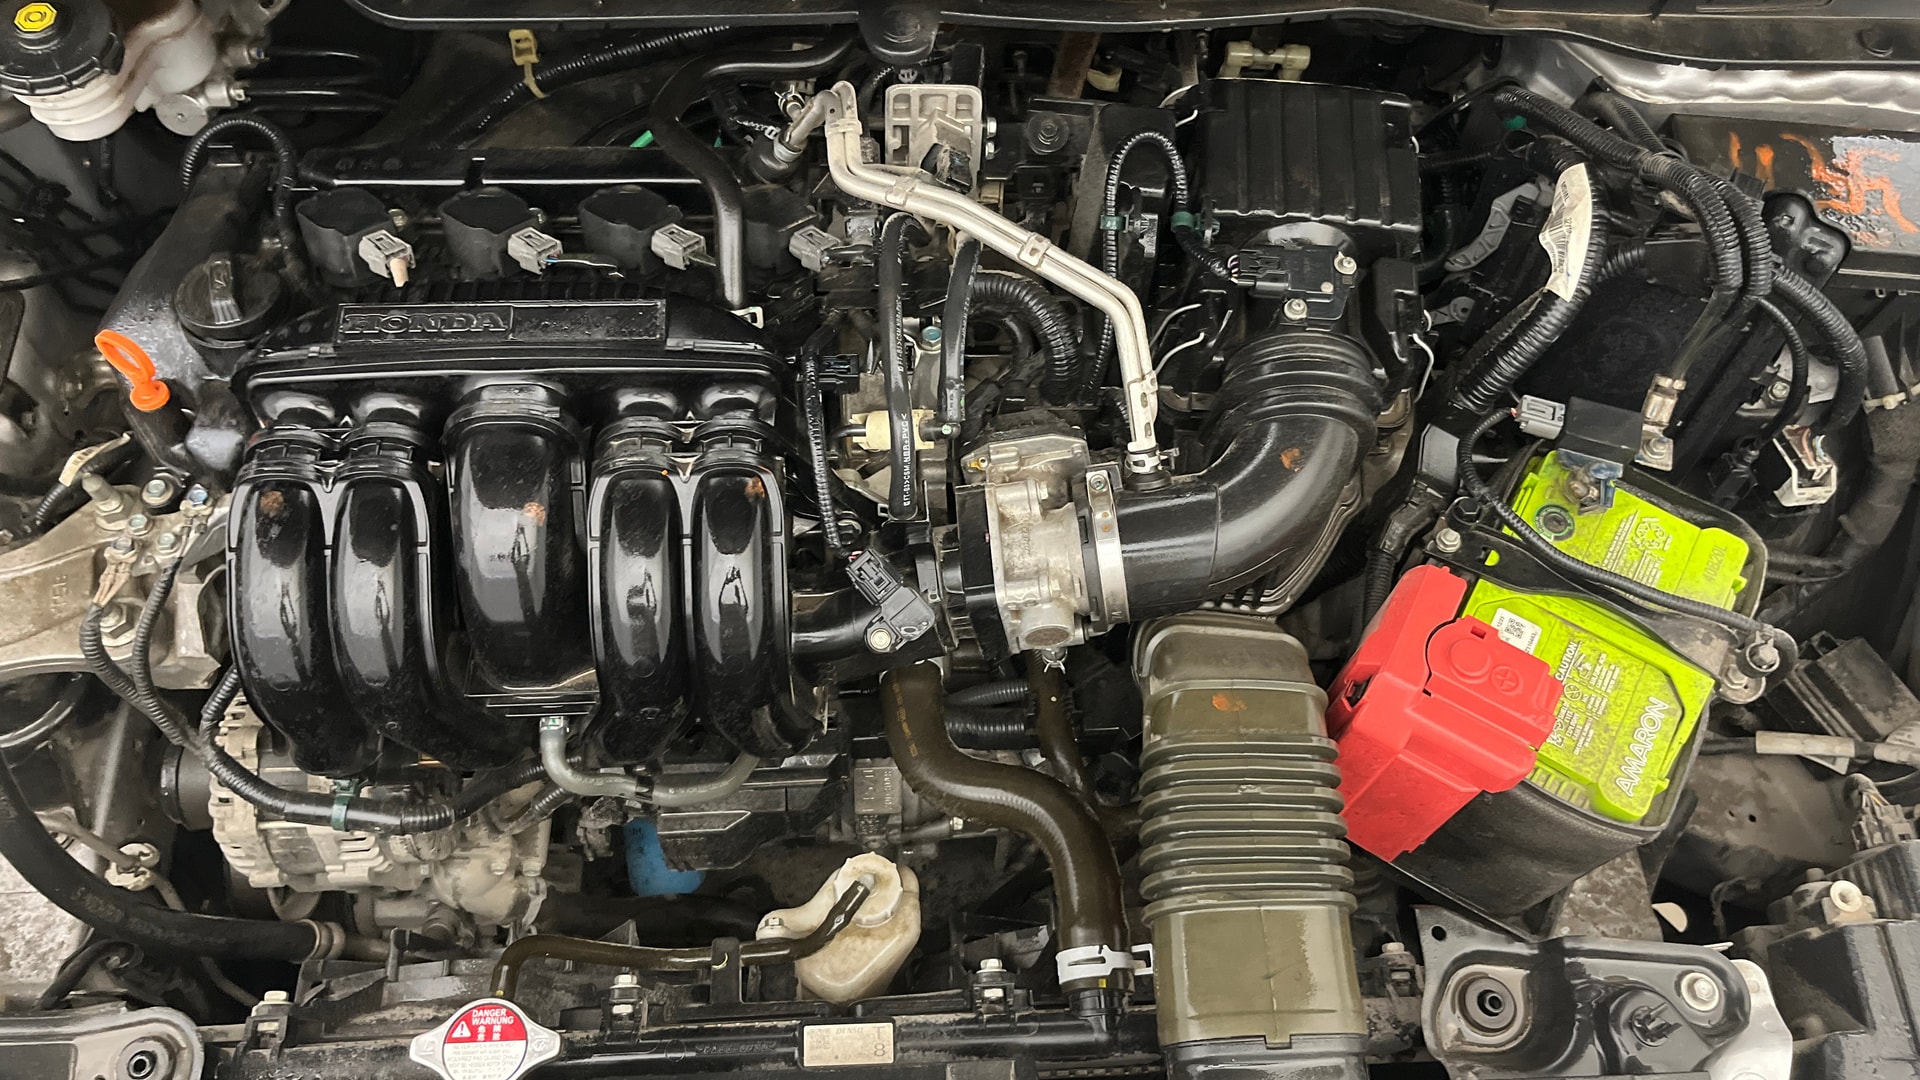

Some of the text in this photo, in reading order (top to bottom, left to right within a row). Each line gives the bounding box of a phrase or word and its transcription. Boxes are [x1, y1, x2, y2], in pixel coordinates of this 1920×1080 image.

[344, 312, 509, 334] HONDA
[1555, 641, 1578, 681] CAUTION
[1616, 696, 1669, 797] AMARON
[472, 1008, 507, 1017] DANGER
[472, 1016, 514, 1025] WARNUNG
[872, 1026, 886, 1040] T
[874, 1042, 886, 1057] 8
